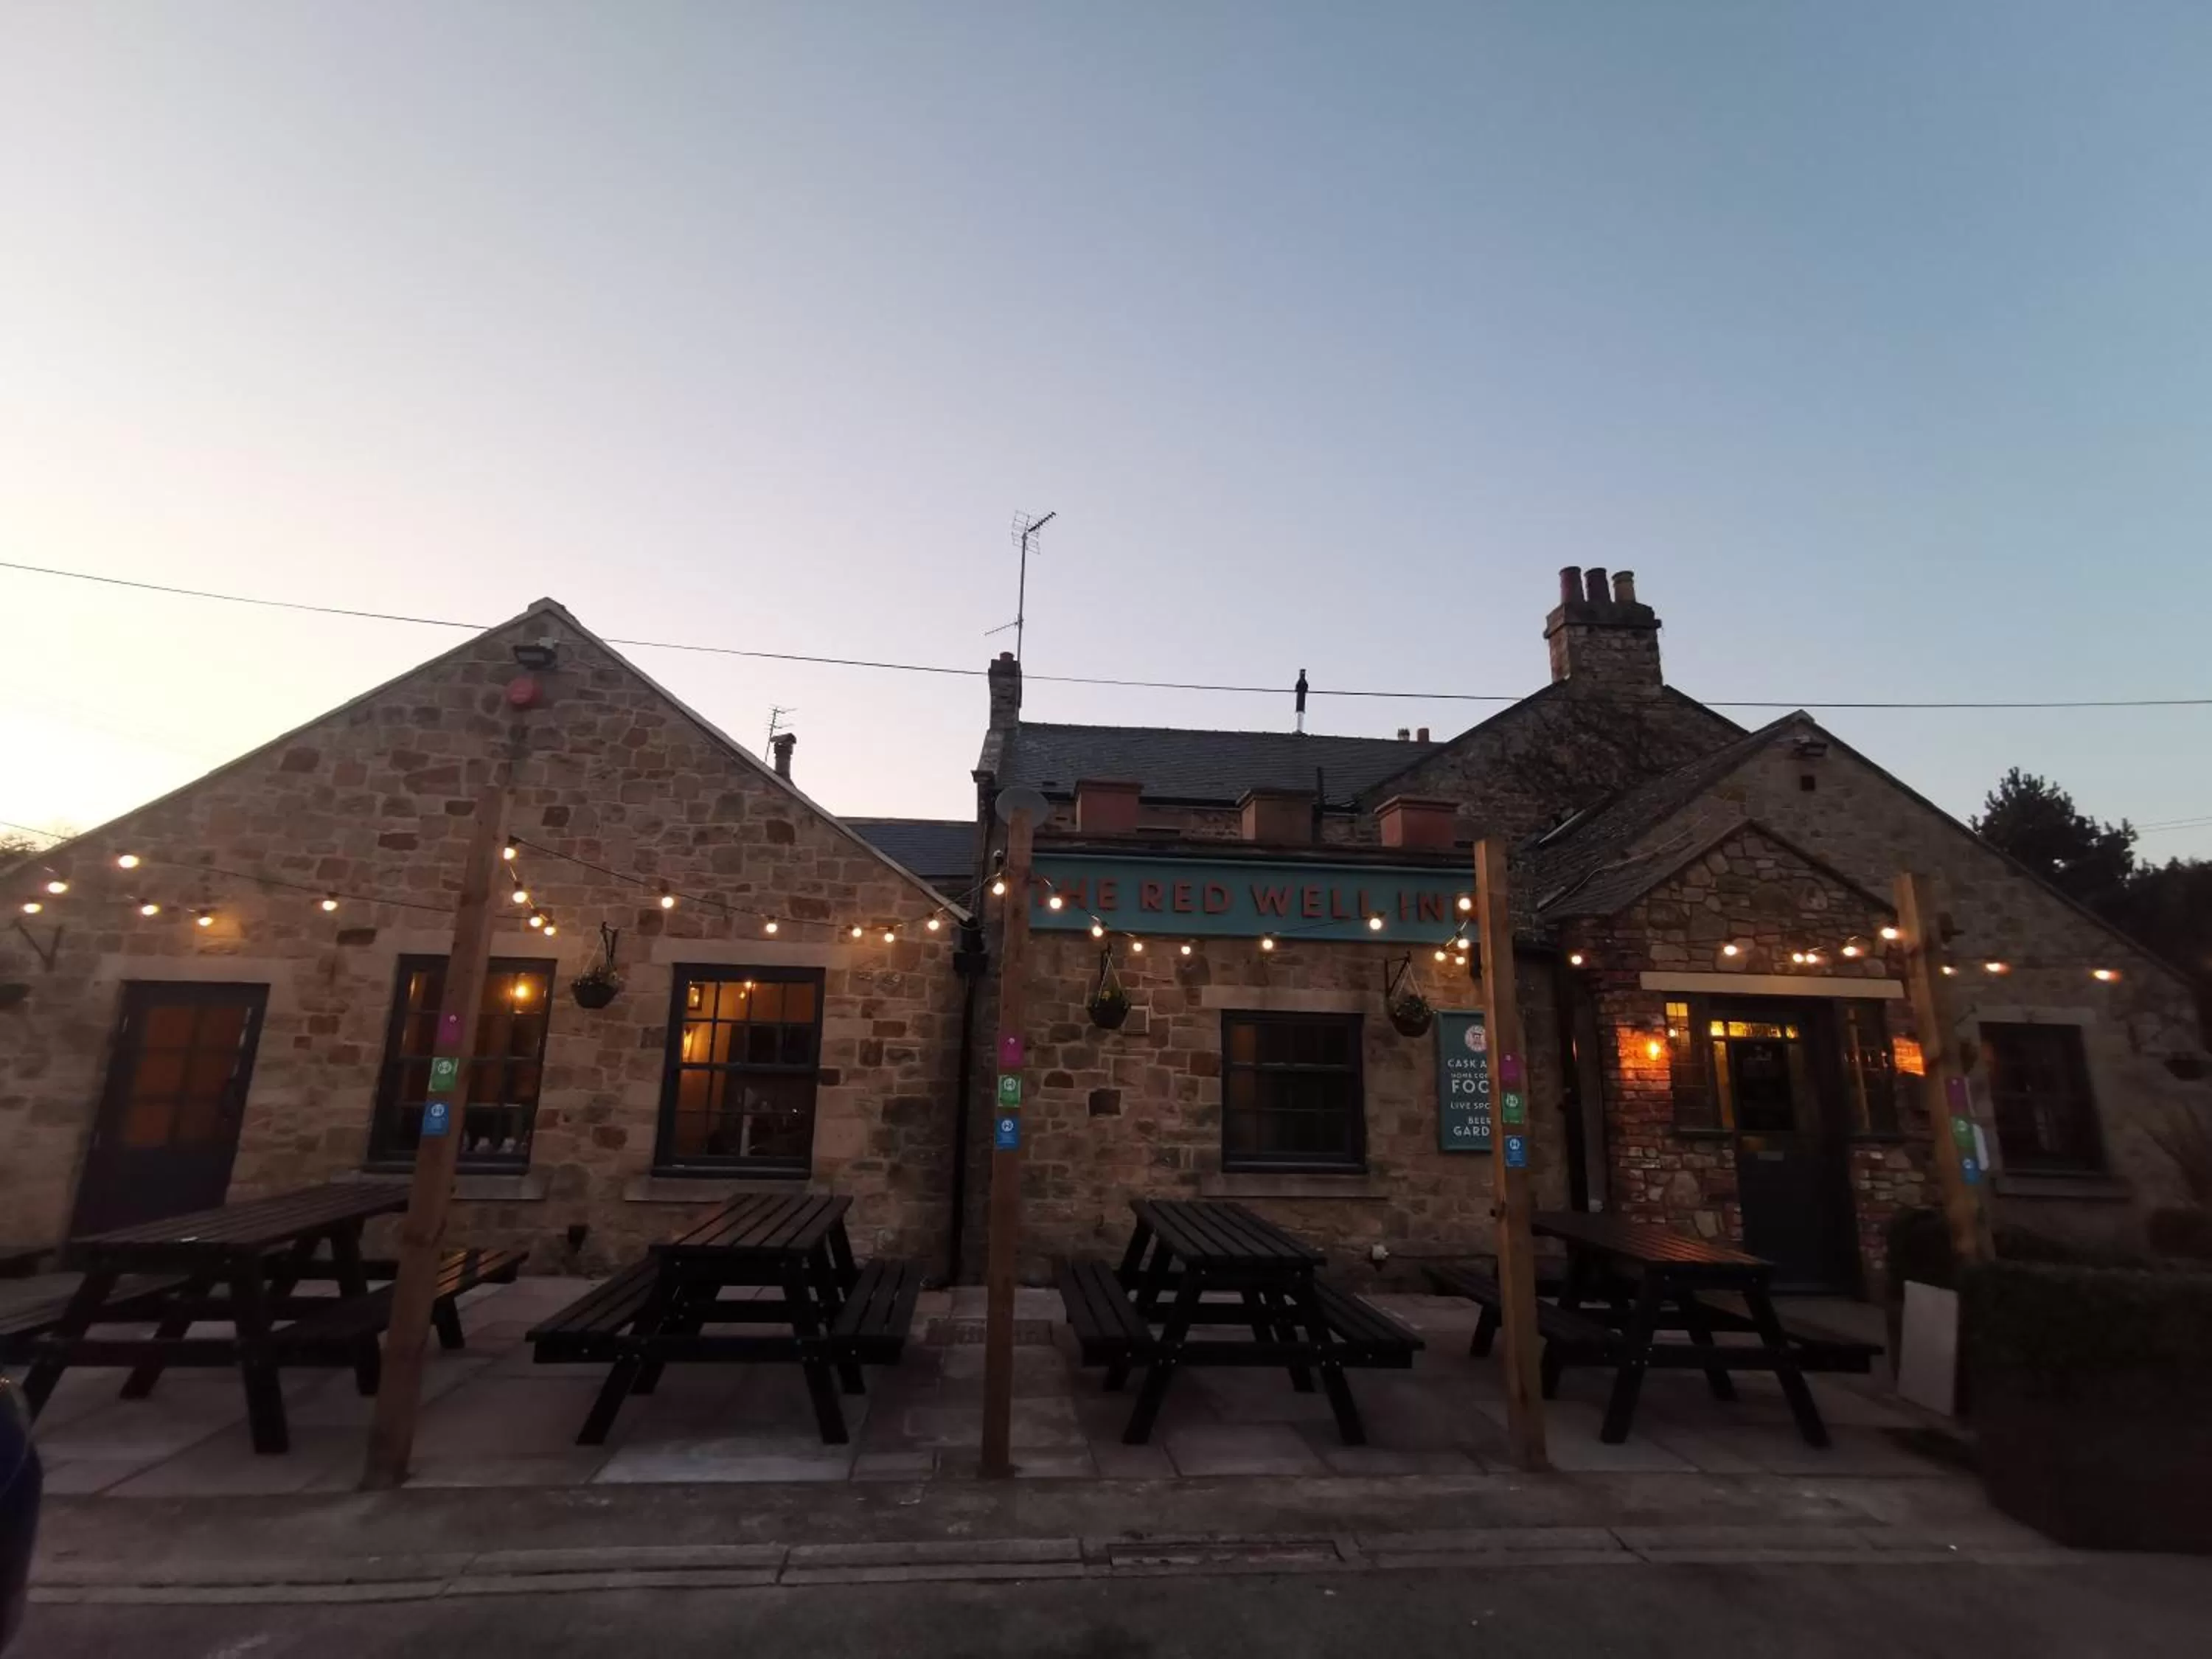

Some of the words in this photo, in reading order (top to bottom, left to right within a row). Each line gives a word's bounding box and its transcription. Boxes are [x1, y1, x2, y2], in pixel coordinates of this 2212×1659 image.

[1139, 878, 1234, 914] RED
[1249, 883, 1376, 921] WELL
[1447, 1058, 1476, 1068] CASK
[1451, 1079, 1490, 1094] FOO
[1450, 1101, 1472, 1110] LIVE
[1453, 1126, 1491, 1137] GARD
